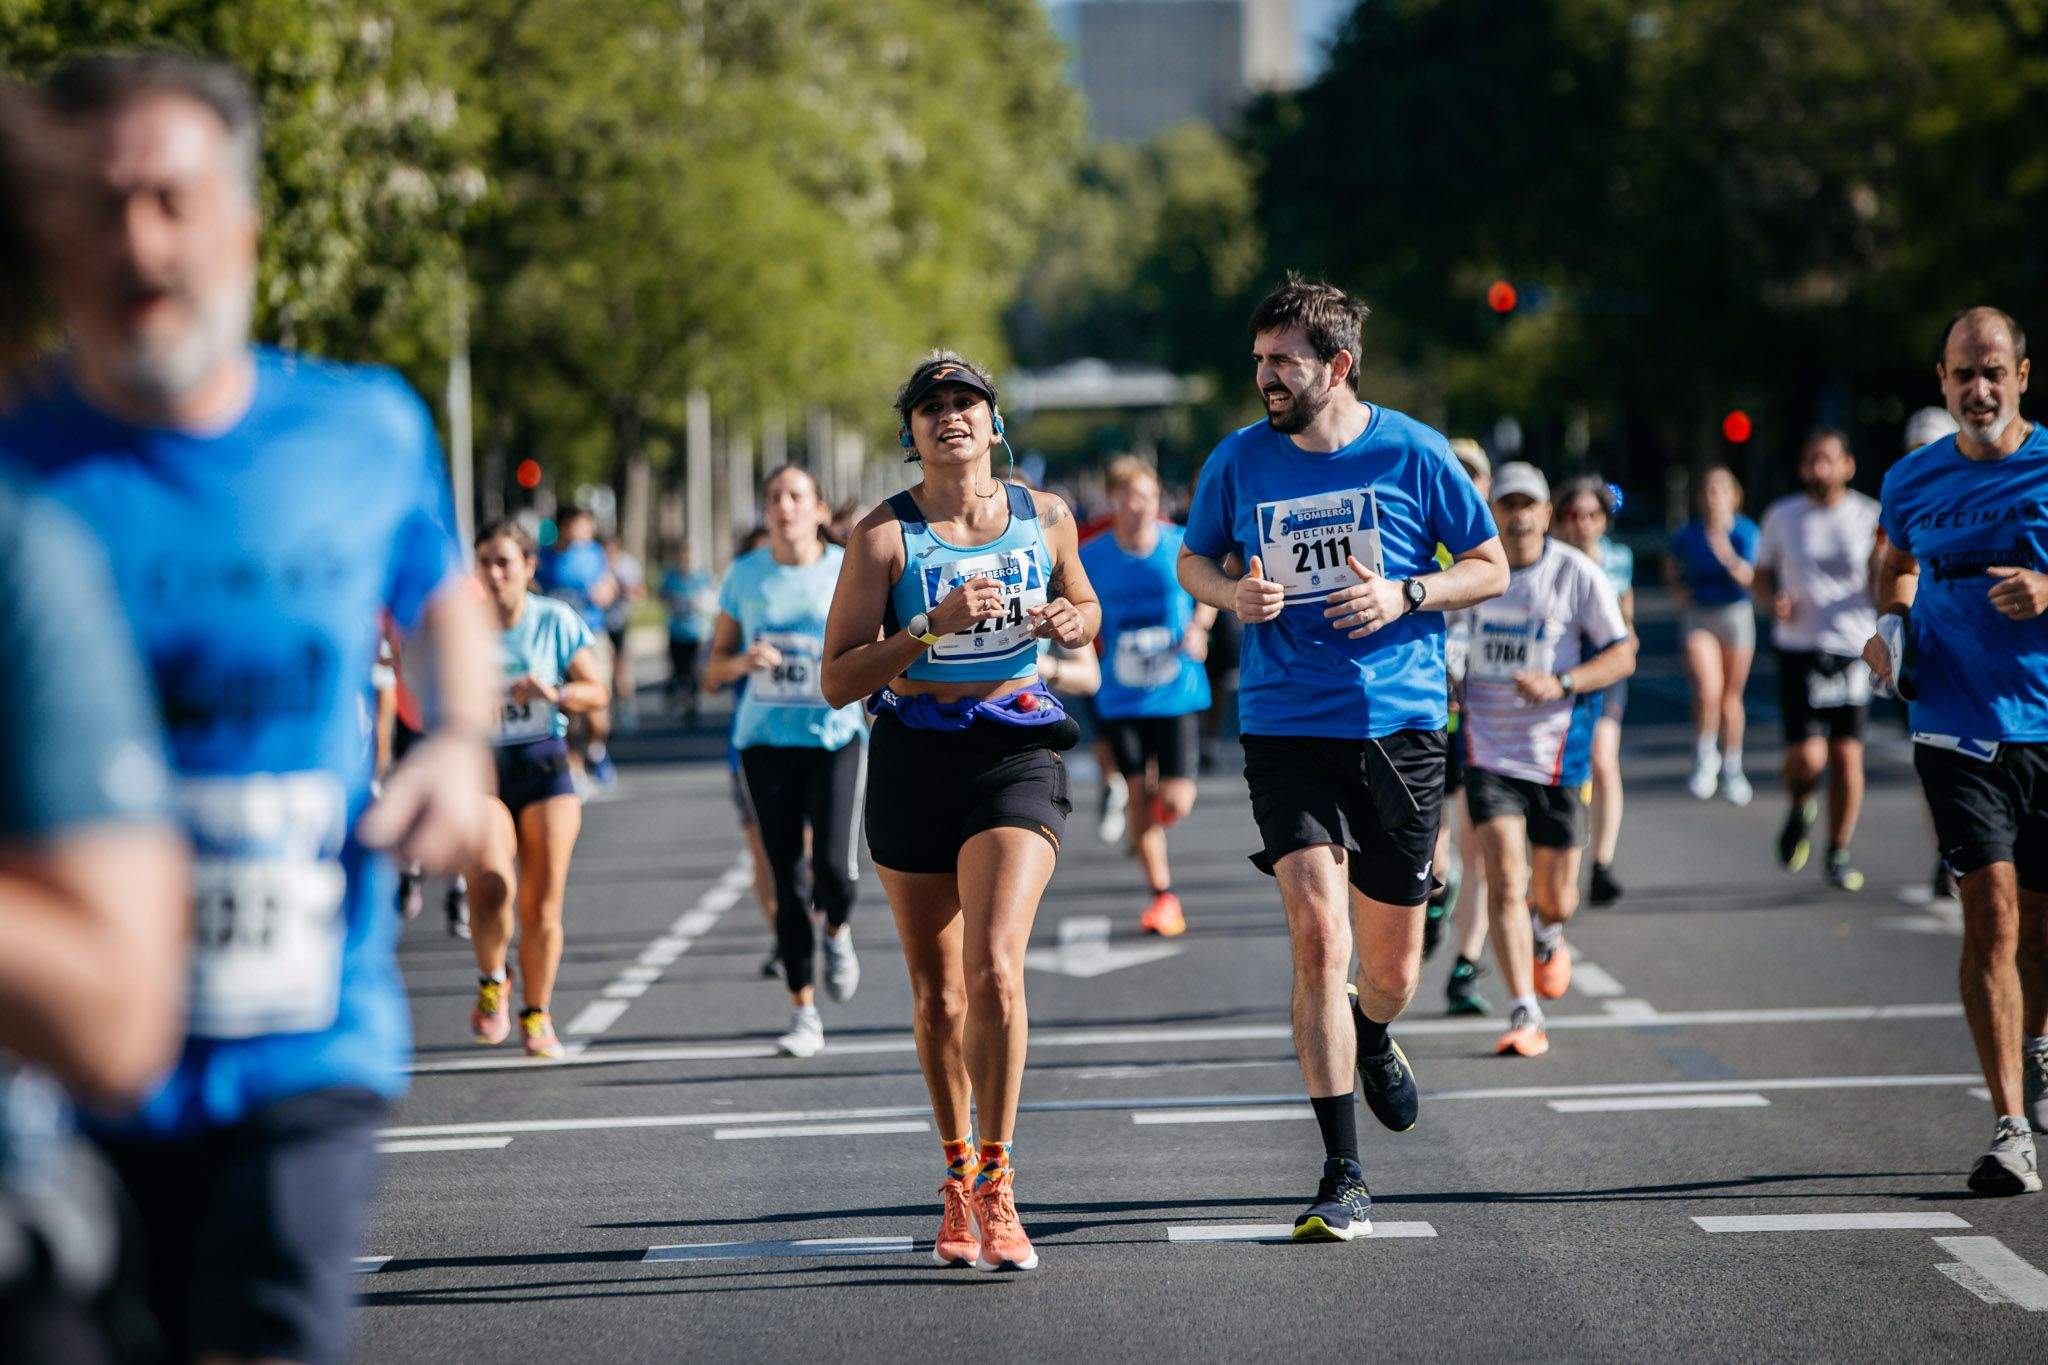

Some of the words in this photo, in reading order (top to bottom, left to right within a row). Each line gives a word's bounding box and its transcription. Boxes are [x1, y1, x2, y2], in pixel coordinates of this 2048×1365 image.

[1297, 507, 1352, 522] BOMBEROS
[1293, 524, 1354, 541] DECIMAS
[1292, 536, 1352, 574] 2111
